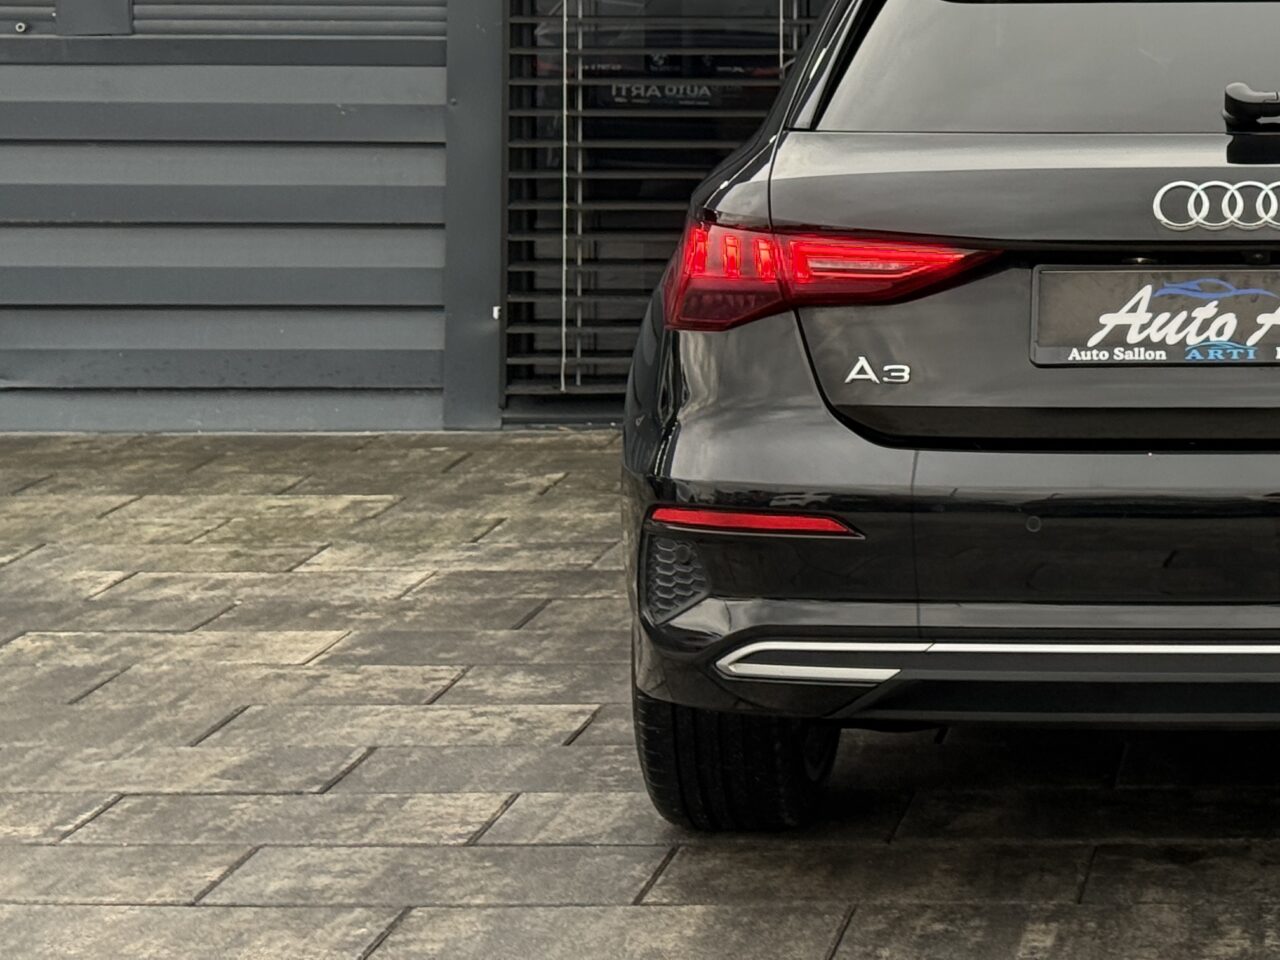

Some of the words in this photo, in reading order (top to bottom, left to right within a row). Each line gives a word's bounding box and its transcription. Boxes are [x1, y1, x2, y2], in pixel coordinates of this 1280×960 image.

[1086, 284, 1238, 347] Auto
[1068, 347, 1110, 361] Auto
[1113, 346, 1167, 361] Sallon
[1184, 349, 1257, 361] ARTI
[844, 355, 911, 384] A3
